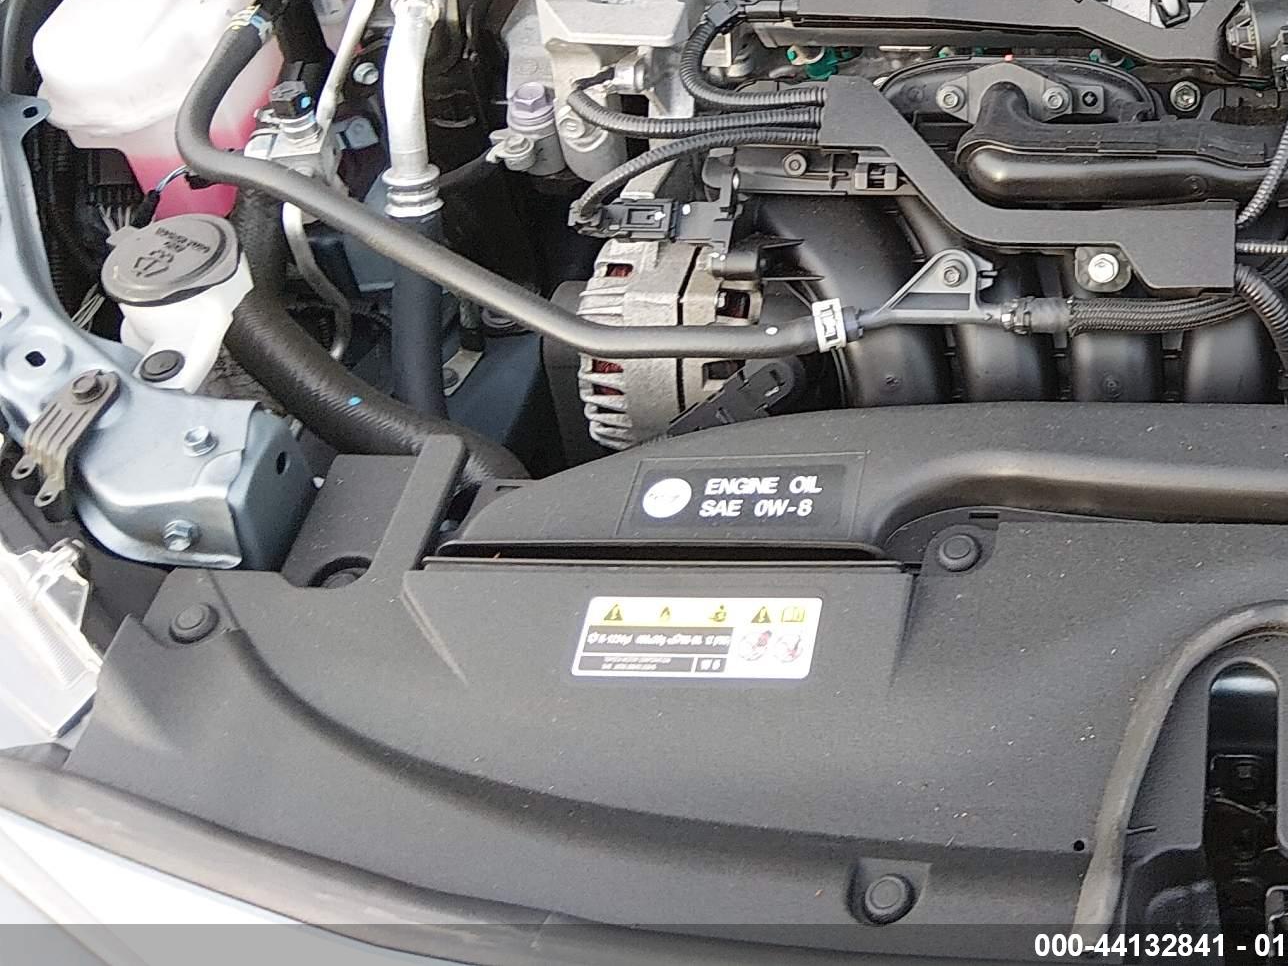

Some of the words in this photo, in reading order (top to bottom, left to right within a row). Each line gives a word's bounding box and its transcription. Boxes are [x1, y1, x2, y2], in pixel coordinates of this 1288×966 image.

[704, 476, 780, 495] ENGINE
[788, 475, 823, 494] OIL
[699, 499, 744, 517] SAE
